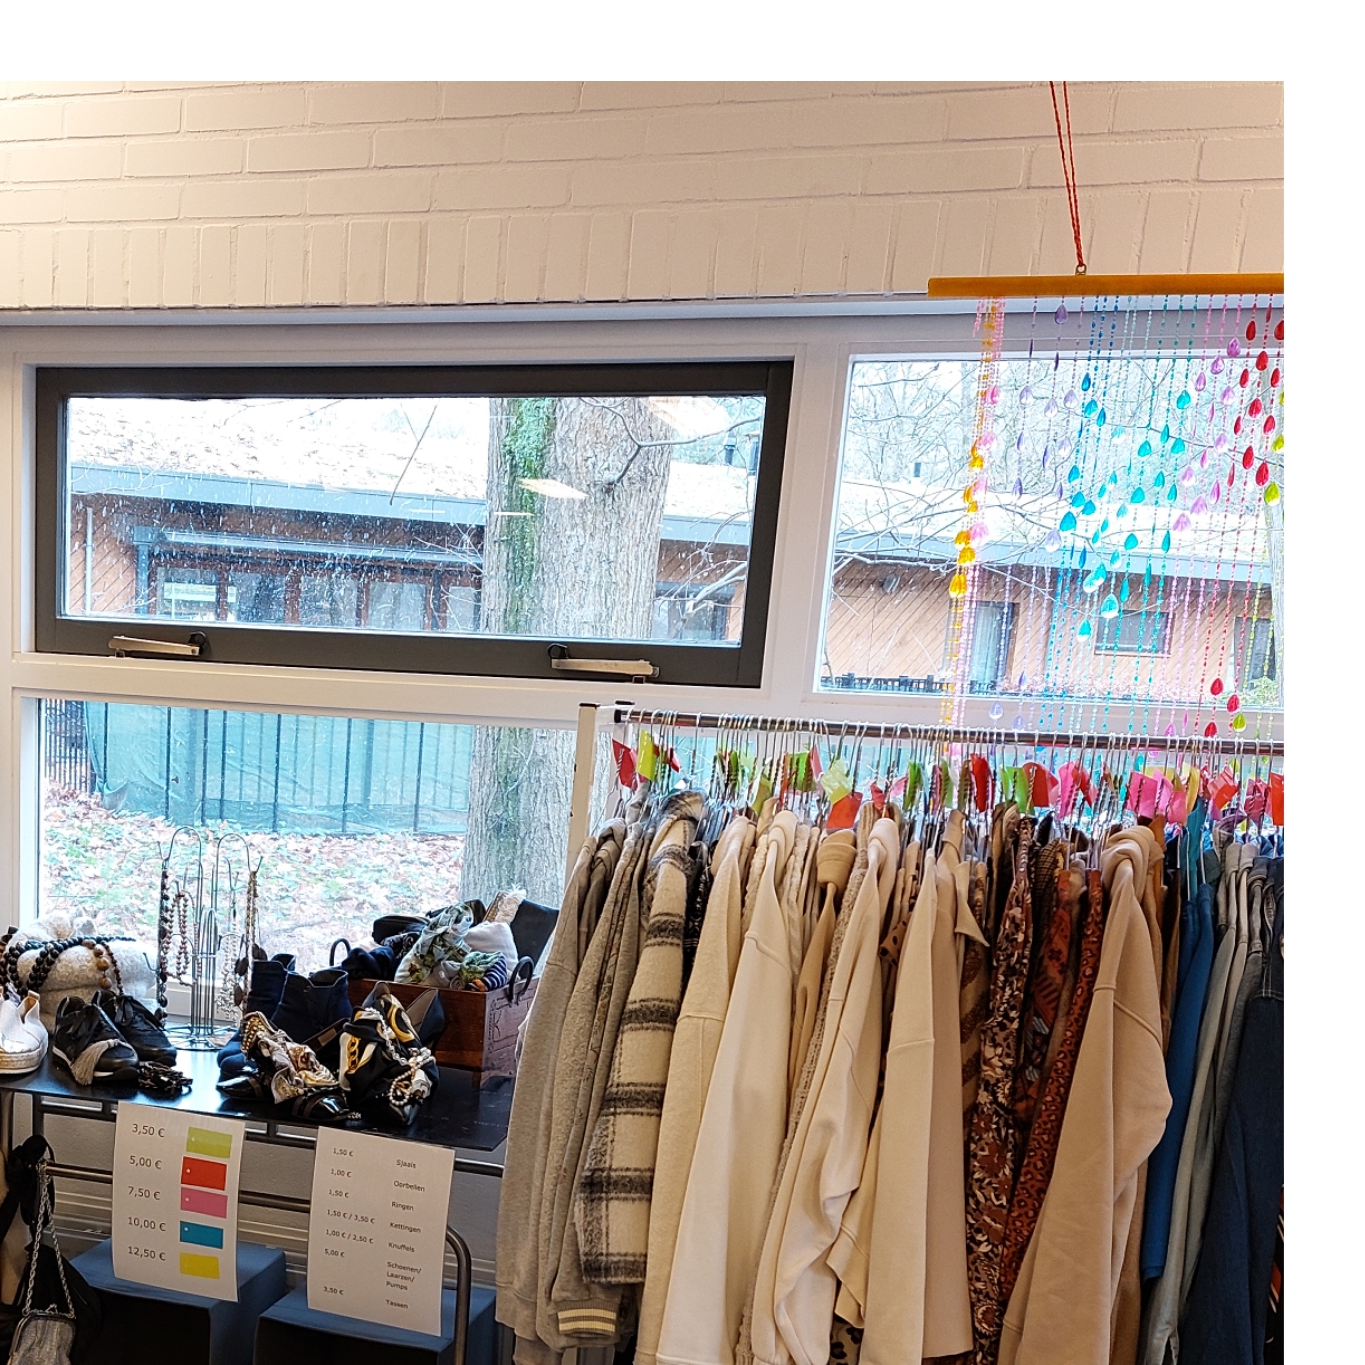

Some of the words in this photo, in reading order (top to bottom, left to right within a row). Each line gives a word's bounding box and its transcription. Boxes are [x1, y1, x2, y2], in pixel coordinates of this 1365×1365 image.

[132, 1123, 155, 1136] 3,50
[158, 1127, 165, 1138] €
[333, 1147, 348, 1156] 1,50
[129, 1155, 152, 1168] 5,00
[154, 1160, 162, 1170] €
[396, 1159, 416, 1169] Sjaals
[393, 1180, 426, 1193] Oorbellen
[128, 1185, 150, 1199] 7,50
[153, 1191, 161, 1201] €
[329, 1189, 343, 1197] 1,50
[391, 1201, 414, 1212] Ringen
[327, 1209, 341, 1217] 1,50
[128, 1216, 156, 1230] 10,00
[159, 1222, 166, 1232] €
[389, 1222, 421, 1234] Kettingen
[388, 1242, 415, 1253] Knuffels
[128, 1246, 156, 1260] 12,50
[159, 1251, 166, 1262] €
[386, 1281, 408, 1291] Pumps
[385, 1299, 409, 1309] Tassen
